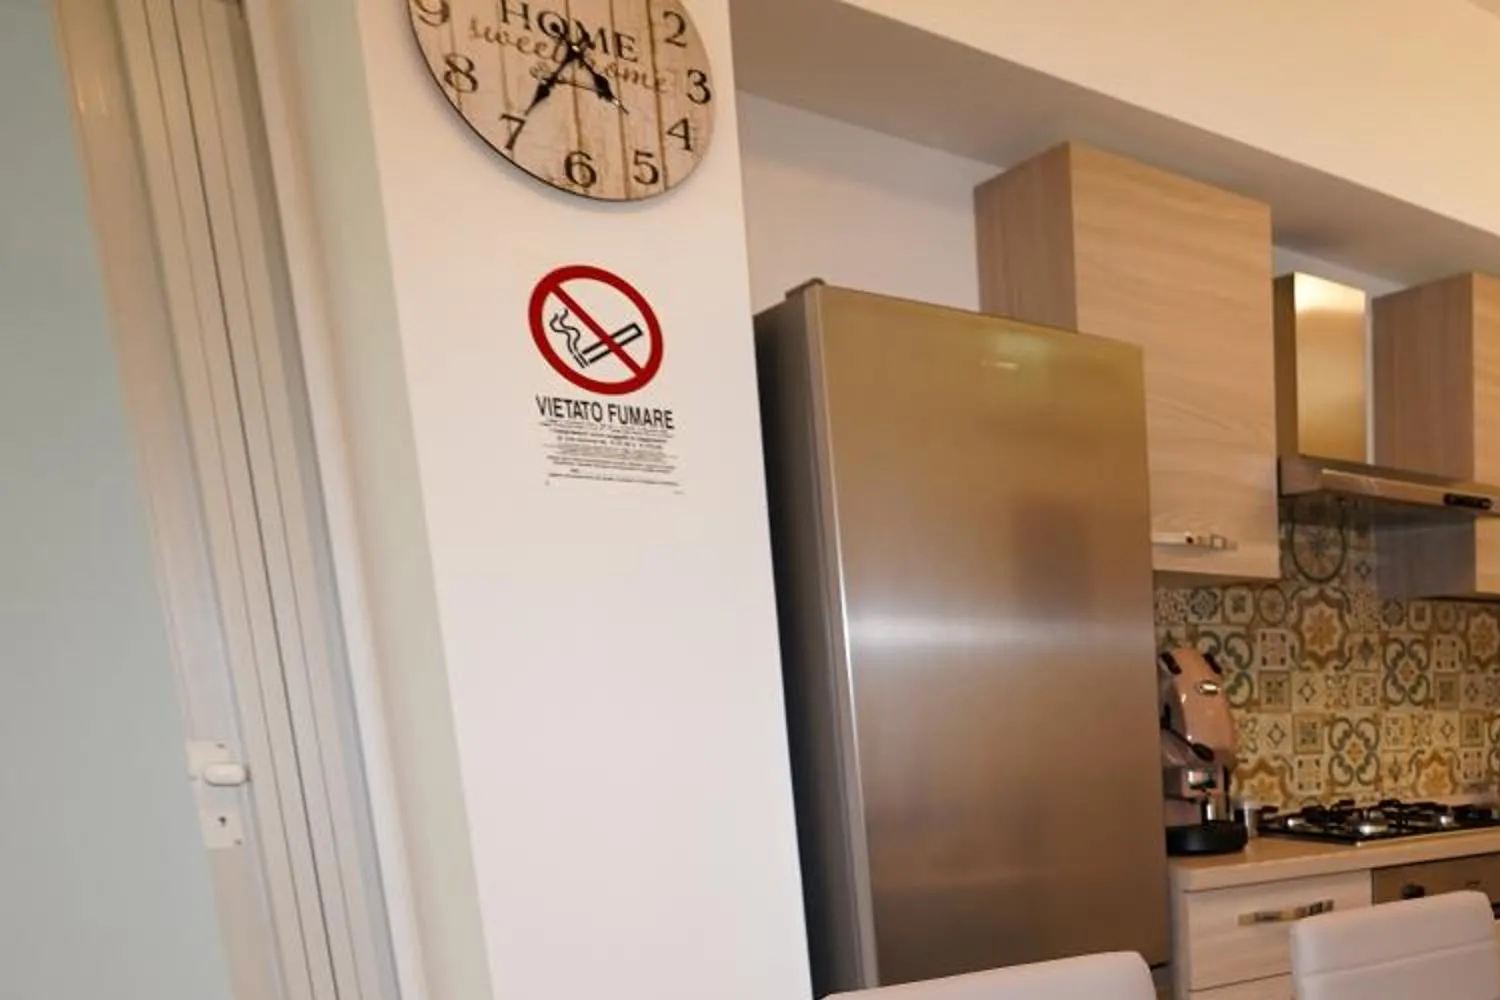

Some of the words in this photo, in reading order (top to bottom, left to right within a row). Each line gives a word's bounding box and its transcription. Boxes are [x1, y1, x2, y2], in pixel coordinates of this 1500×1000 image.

[501, 0, 638, 63] HOME
[662, 11, 687, 48] 2
[443, 53, 479, 93] 8
[686, 69, 712, 105] 3
[499, 113, 526, 151] 7
[666, 117, 693, 151] 4
[563, 150, 597, 189] 6
[633, 149, 659, 186] 5
[535, 394, 603, 422] VIETATO
[608, 404, 674, 429] FUMARE
